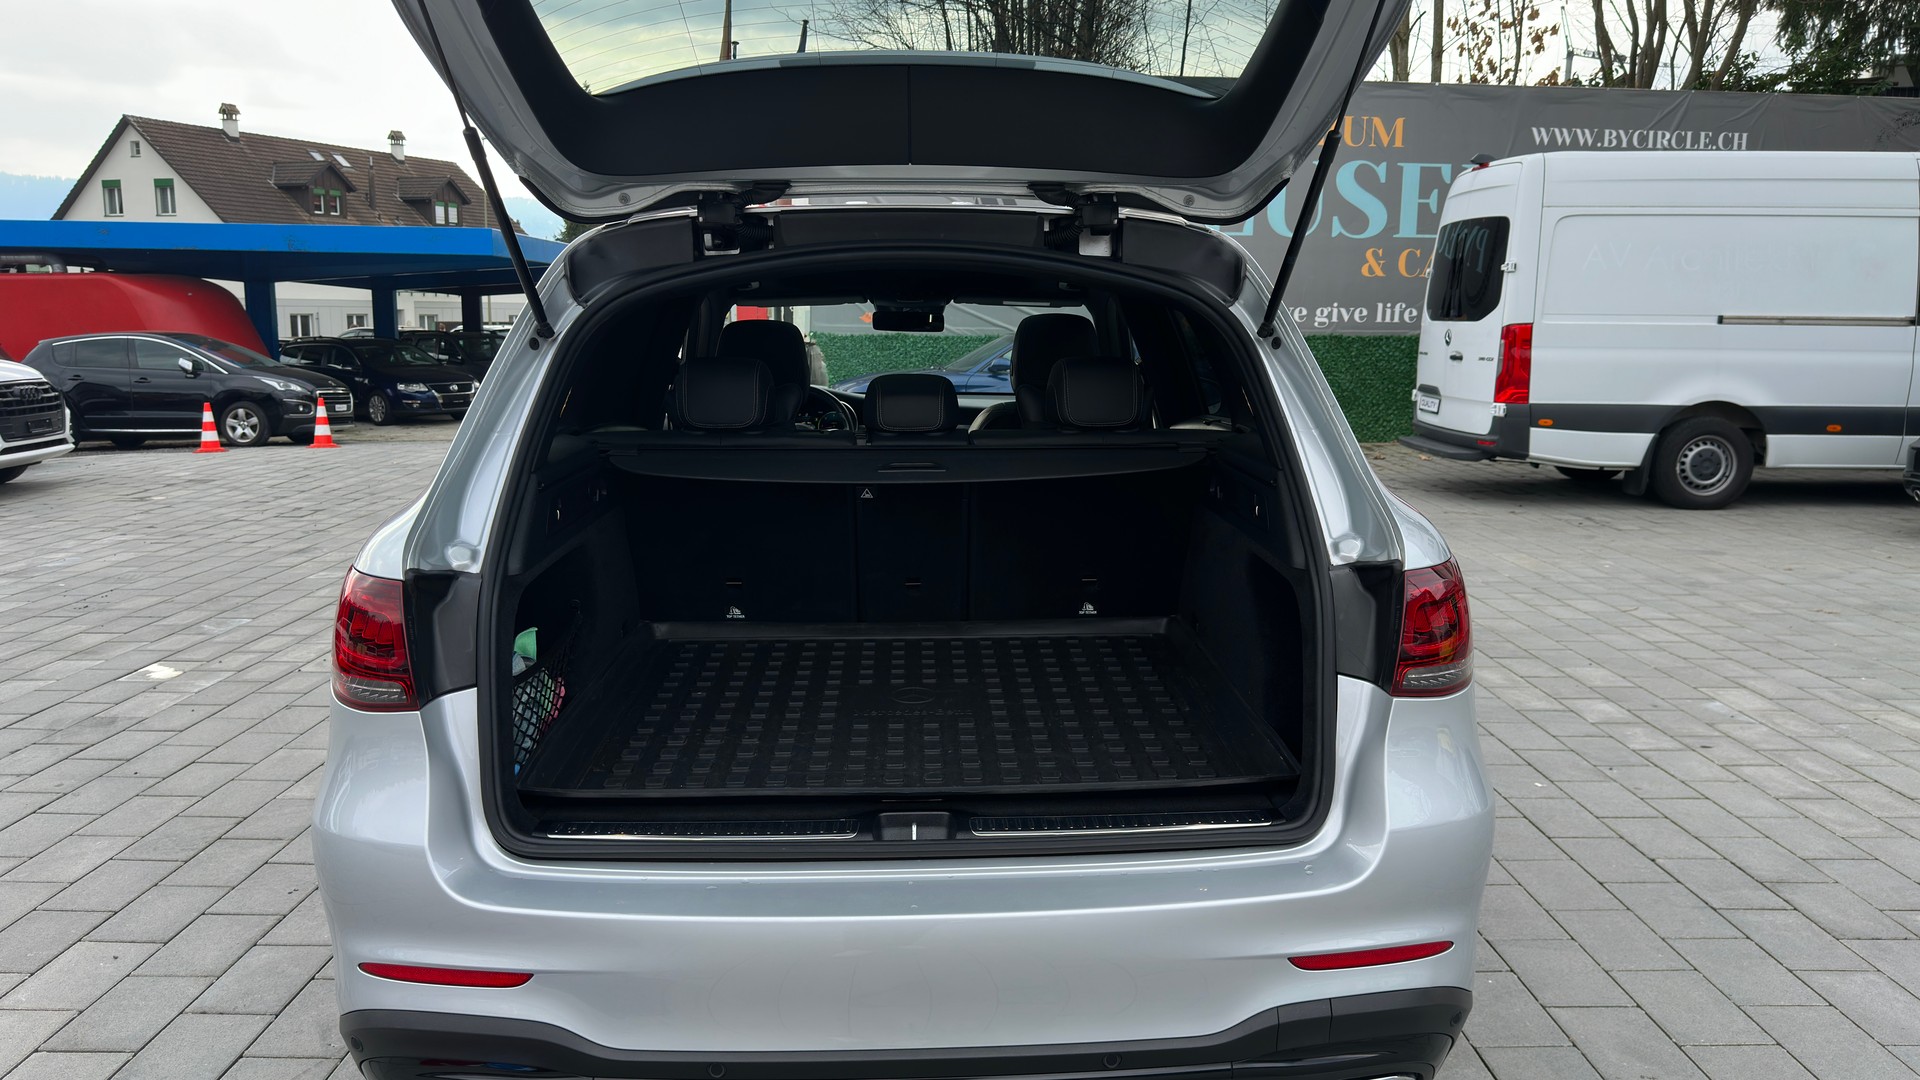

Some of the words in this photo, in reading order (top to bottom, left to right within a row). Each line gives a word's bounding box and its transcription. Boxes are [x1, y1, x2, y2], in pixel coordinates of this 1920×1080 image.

[1531, 126, 1749, 150] WWW.BYCIRCLE.CH
[1361, 248, 1386, 277] &
[1313, 302, 1368, 328] give
[1375, 302, 1418, 323] life
